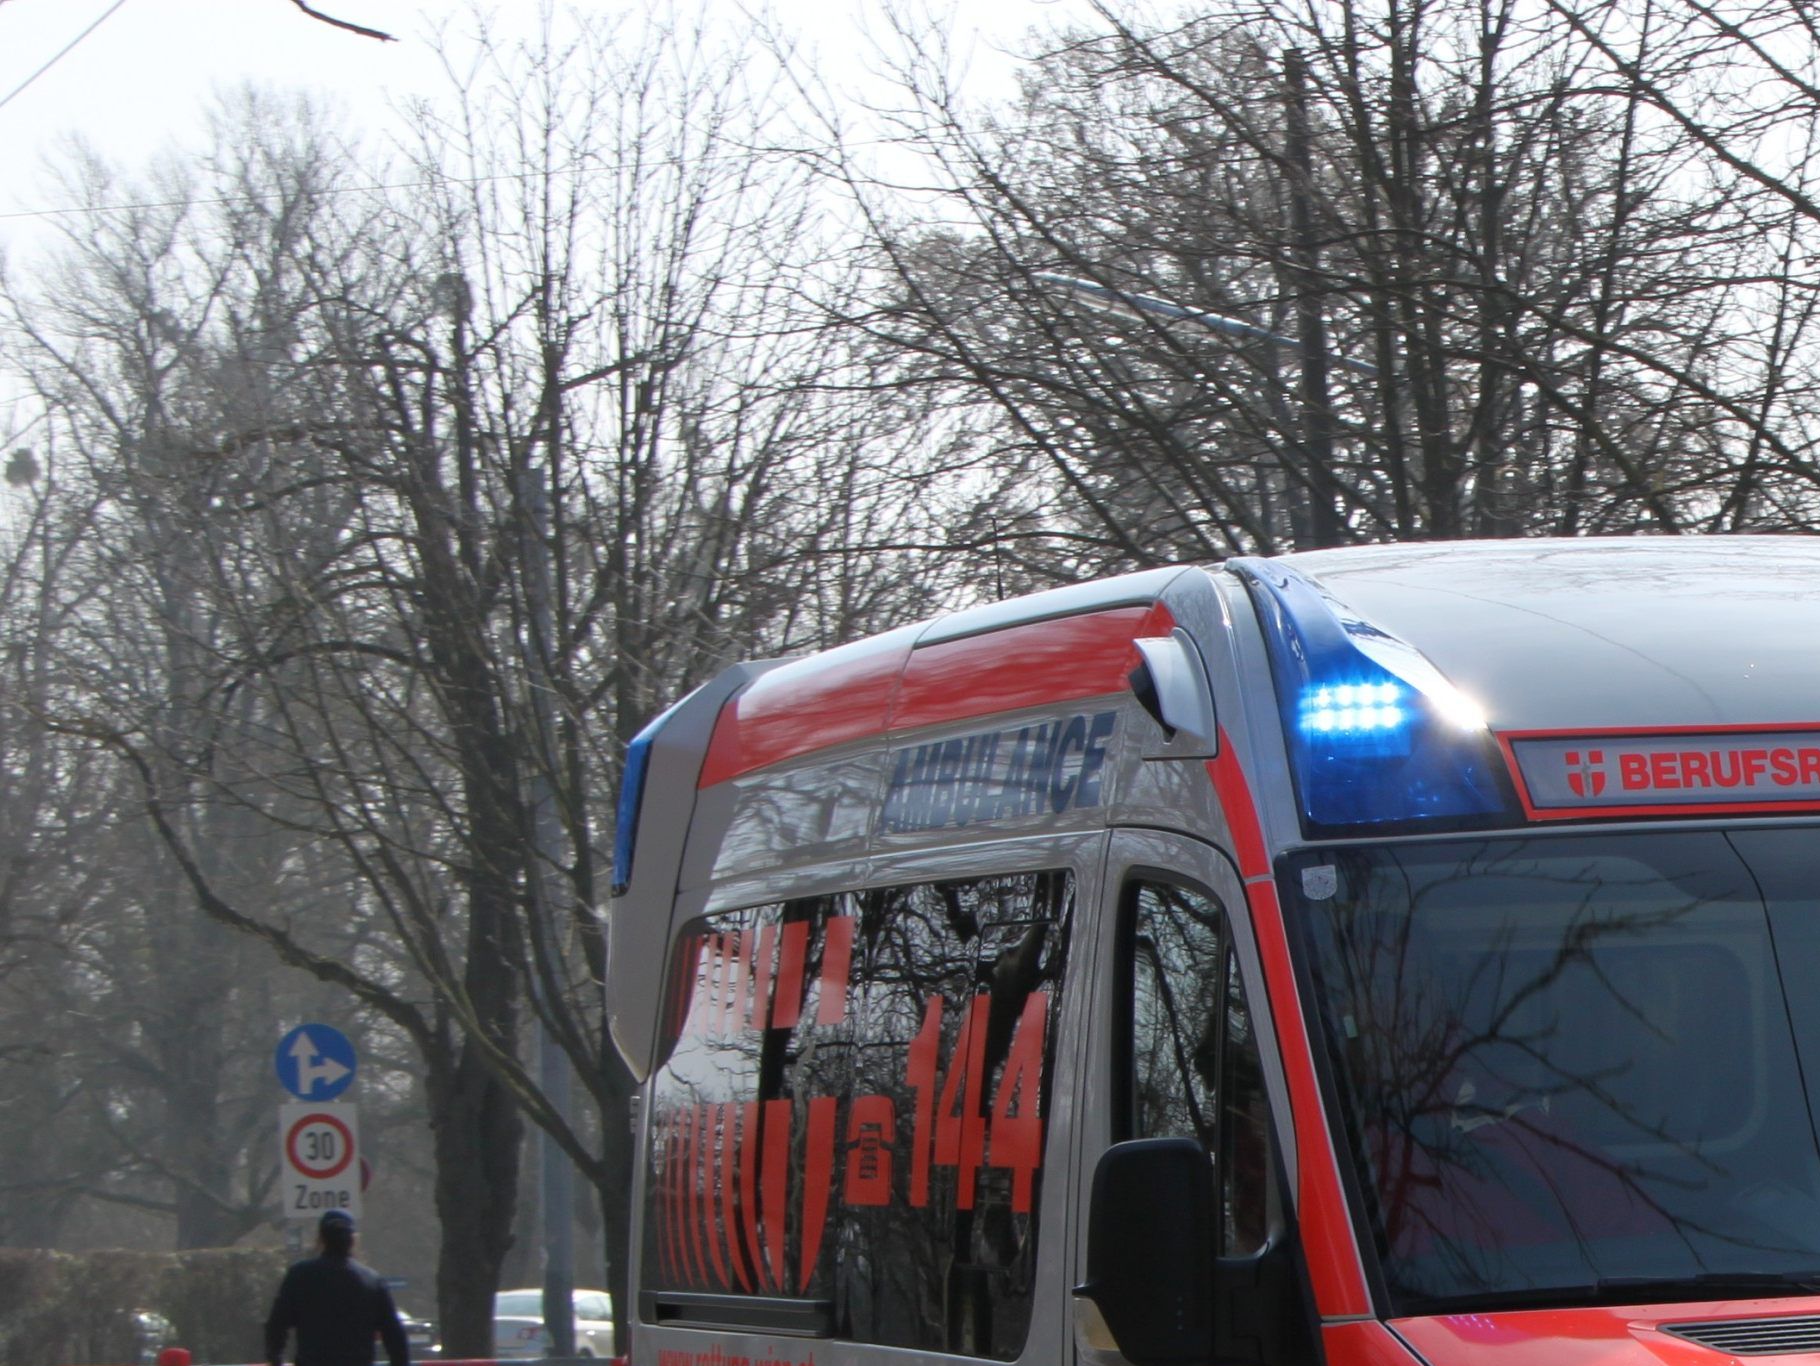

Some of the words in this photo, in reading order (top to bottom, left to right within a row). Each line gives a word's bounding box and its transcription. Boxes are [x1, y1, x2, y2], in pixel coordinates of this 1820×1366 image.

[880, 711, 1117, 836] AMBULANCE
[906, 992, 1048, 1213] 144
[305, 1131, 336, 1160] 30
[295, 1185, 351, 1209] Zone
